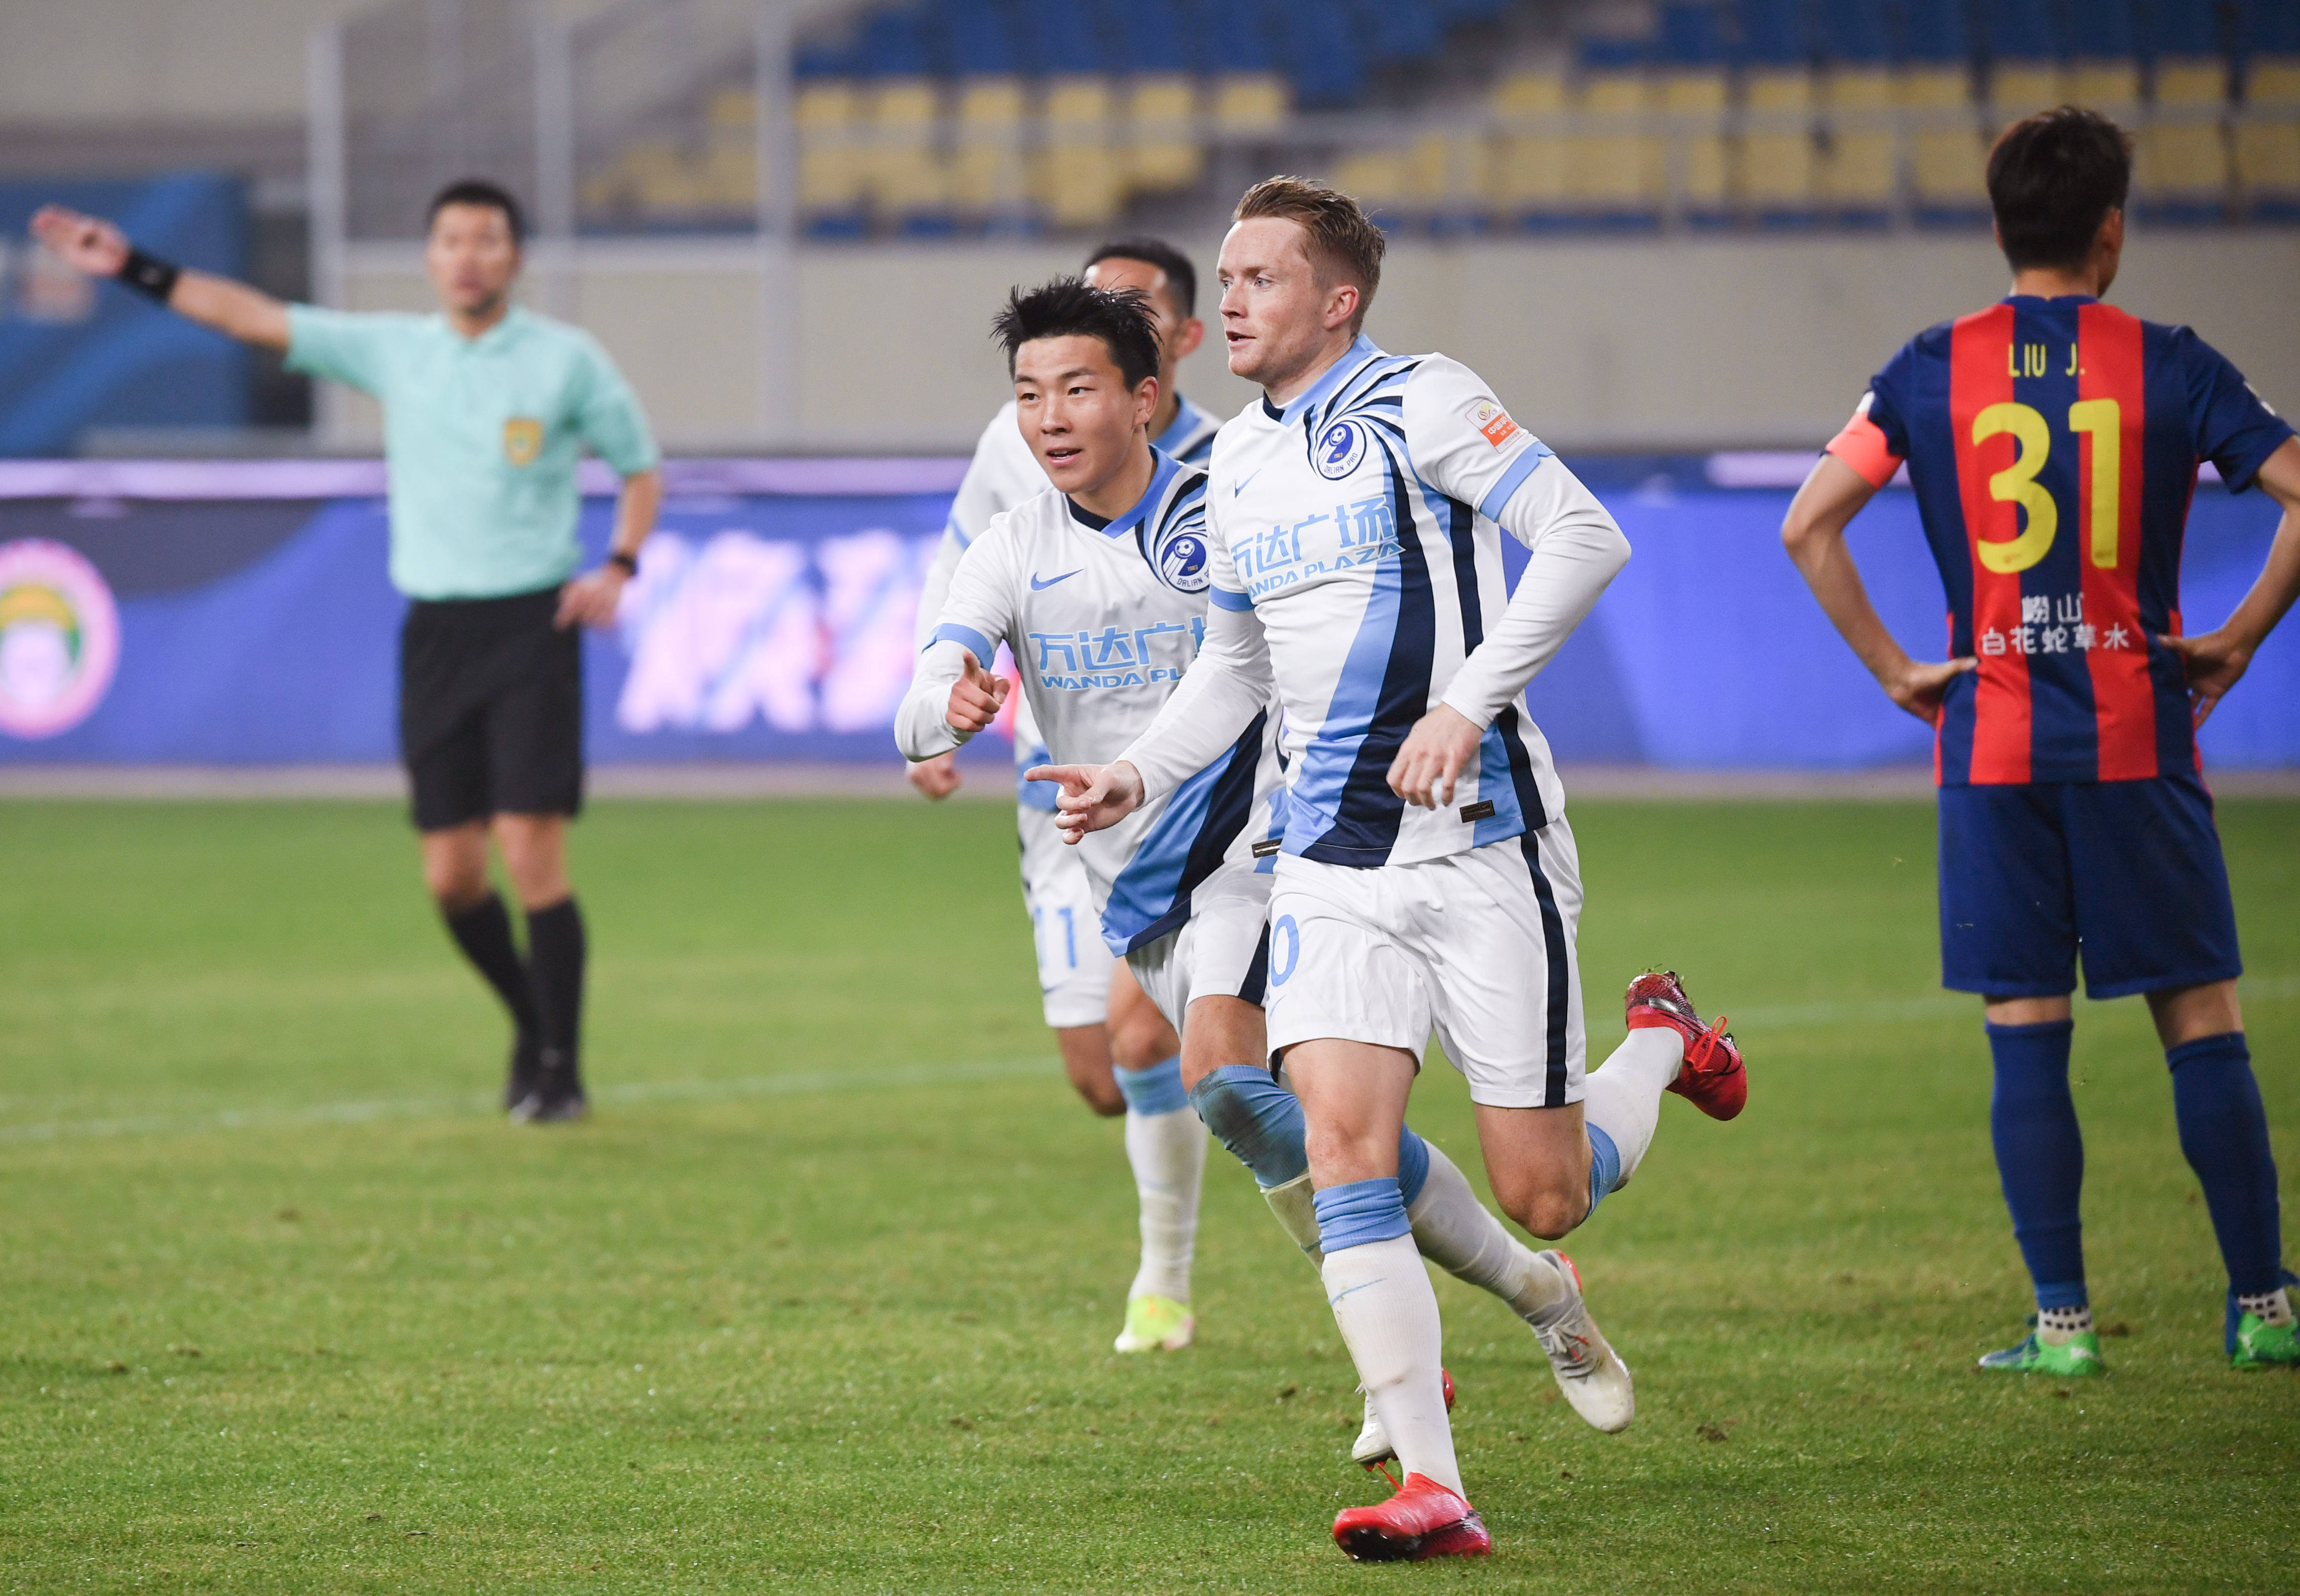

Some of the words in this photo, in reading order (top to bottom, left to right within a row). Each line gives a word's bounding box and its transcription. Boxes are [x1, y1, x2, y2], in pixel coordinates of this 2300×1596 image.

[2008, 343, 2046, 378] LIU
[2066, 342, 2086, 376] J.
[1324, 464, 1345, 474] DALIAN
[1346, 452, 1358, 466] PRO
[1971, 398, 2120, 574] 31
[1231, 495, 1397, 579] 万达广场
[1176, 577, 1204, 587] DALIAN
[1245, 570, 1299, 600] ANDA
[1303, 541, 1405, 579] PLAZA
[1982, 622, 2130, 656] 白花蛇草水
[1041, 671, 1144, 690] WANDA
[1150, 667, 1185, 683] PL
[1270, 913, 1299, 987] 0
